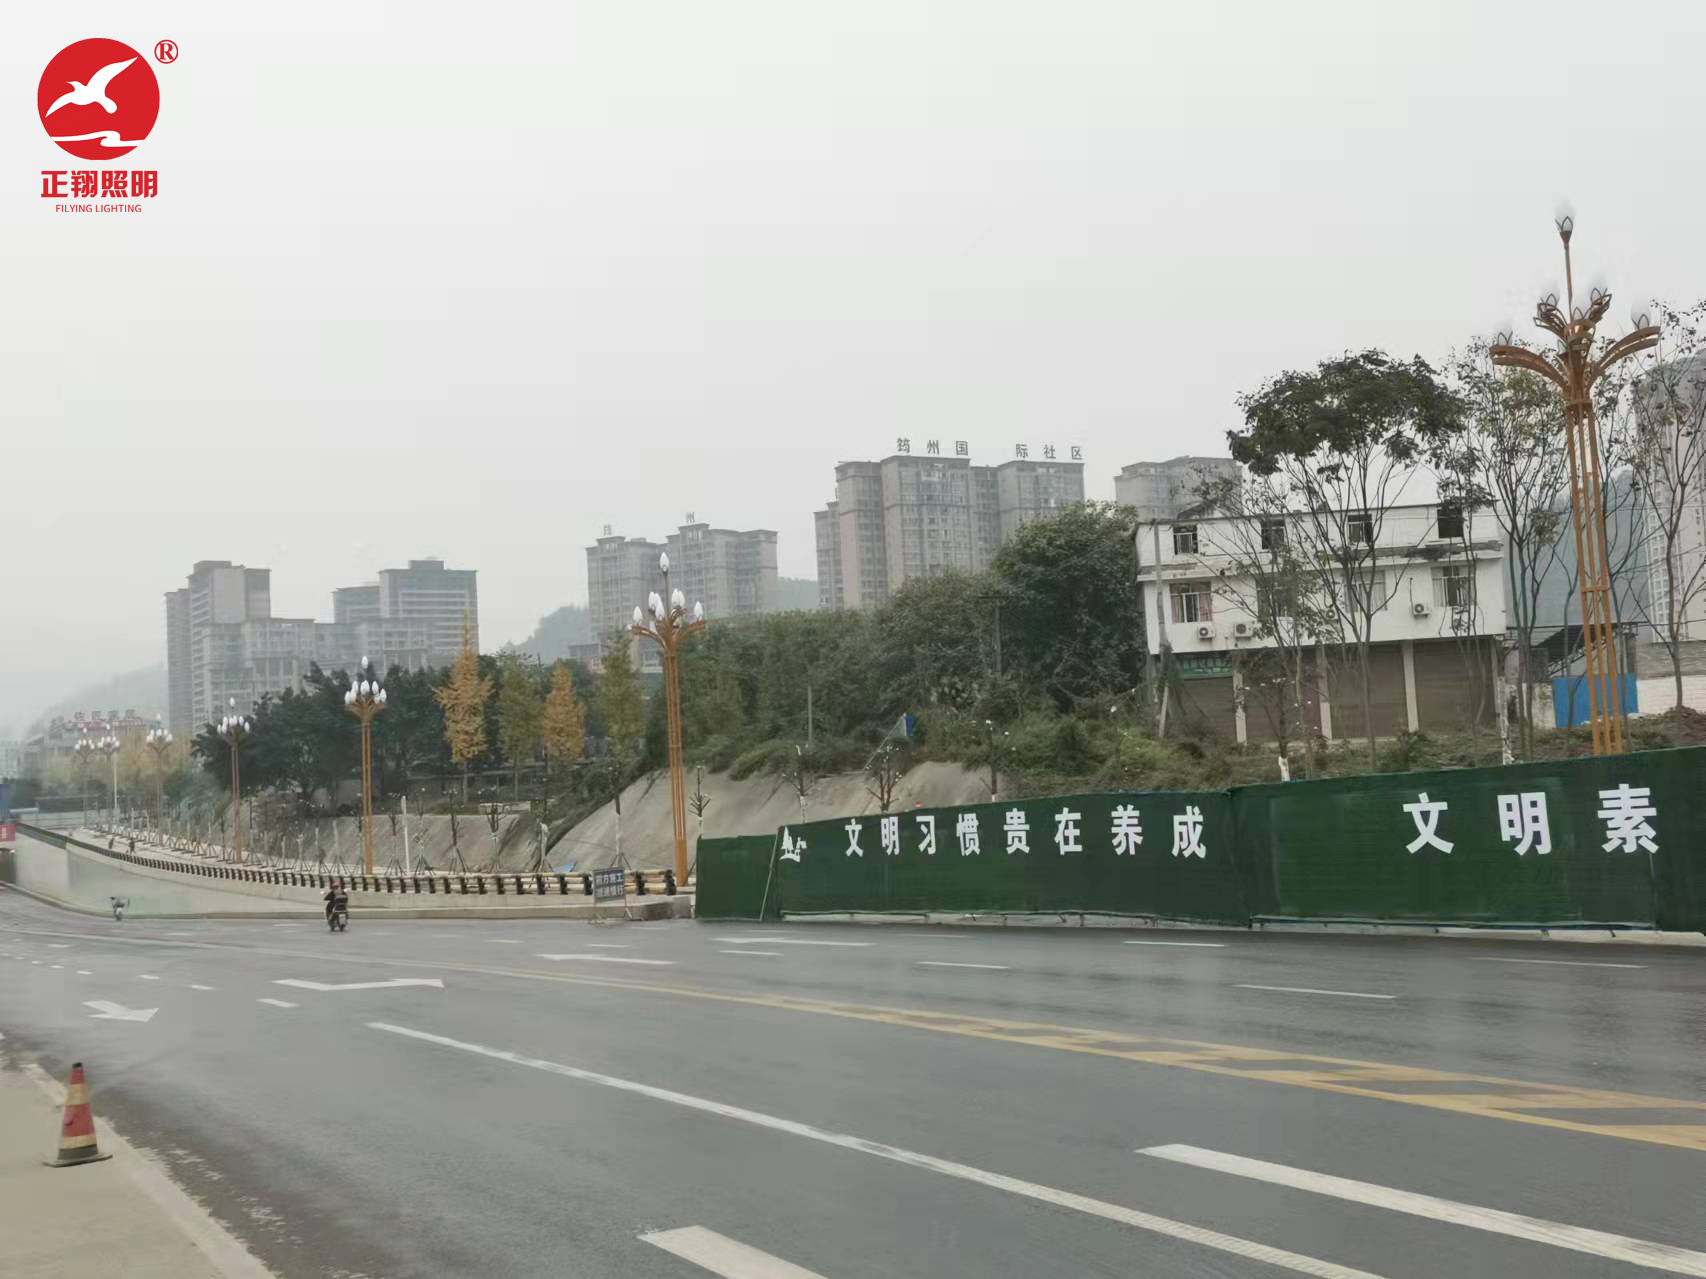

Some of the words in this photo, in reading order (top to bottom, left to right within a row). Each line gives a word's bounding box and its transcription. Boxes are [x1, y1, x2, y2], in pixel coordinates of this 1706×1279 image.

[844, 804, 1207, 859] 文明习惯贵在养成
[1402, 783, 1660, 856] 文明素
